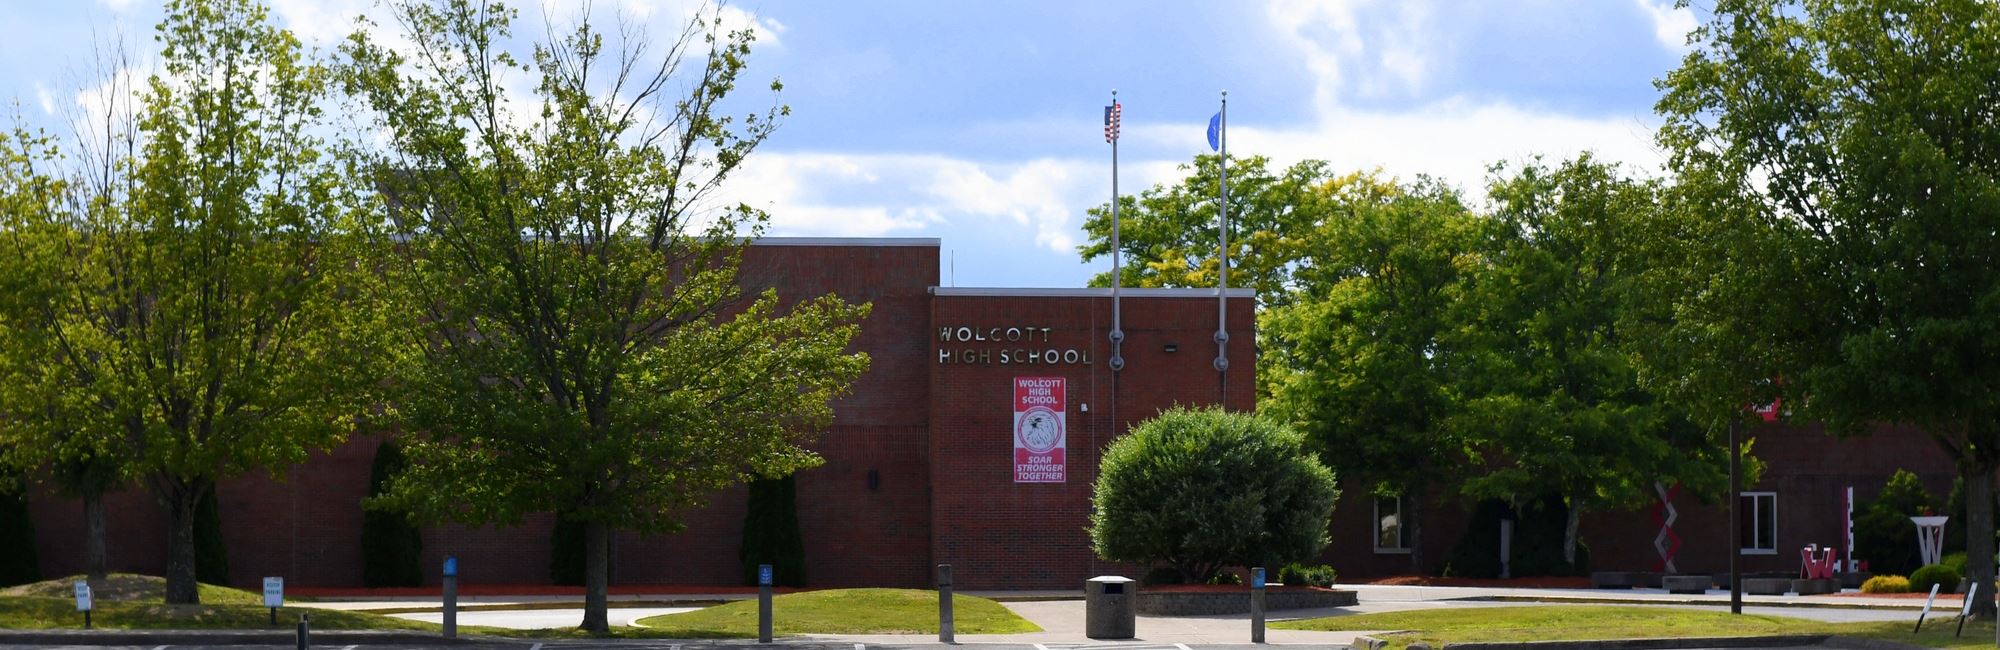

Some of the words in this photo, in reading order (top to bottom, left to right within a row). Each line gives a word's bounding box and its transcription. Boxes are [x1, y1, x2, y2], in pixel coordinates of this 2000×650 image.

[938, 327, 1051, 342] WOLCOTT
[939, 349, 991, 364] HIGH
[1000, 349, 1092, 364] SCHOOL
[1019, 379, 1061, 388] WOLCOTT
[1029, 388, 1051, 396] HIGH
[1022, 396, 1058, 405] SCHOOL
[1028, 456, 1053, 464] SOAR
[1017, 464, 1064, 472] STRONGER
[1018, 472, 1063, 480] TOGETHER
